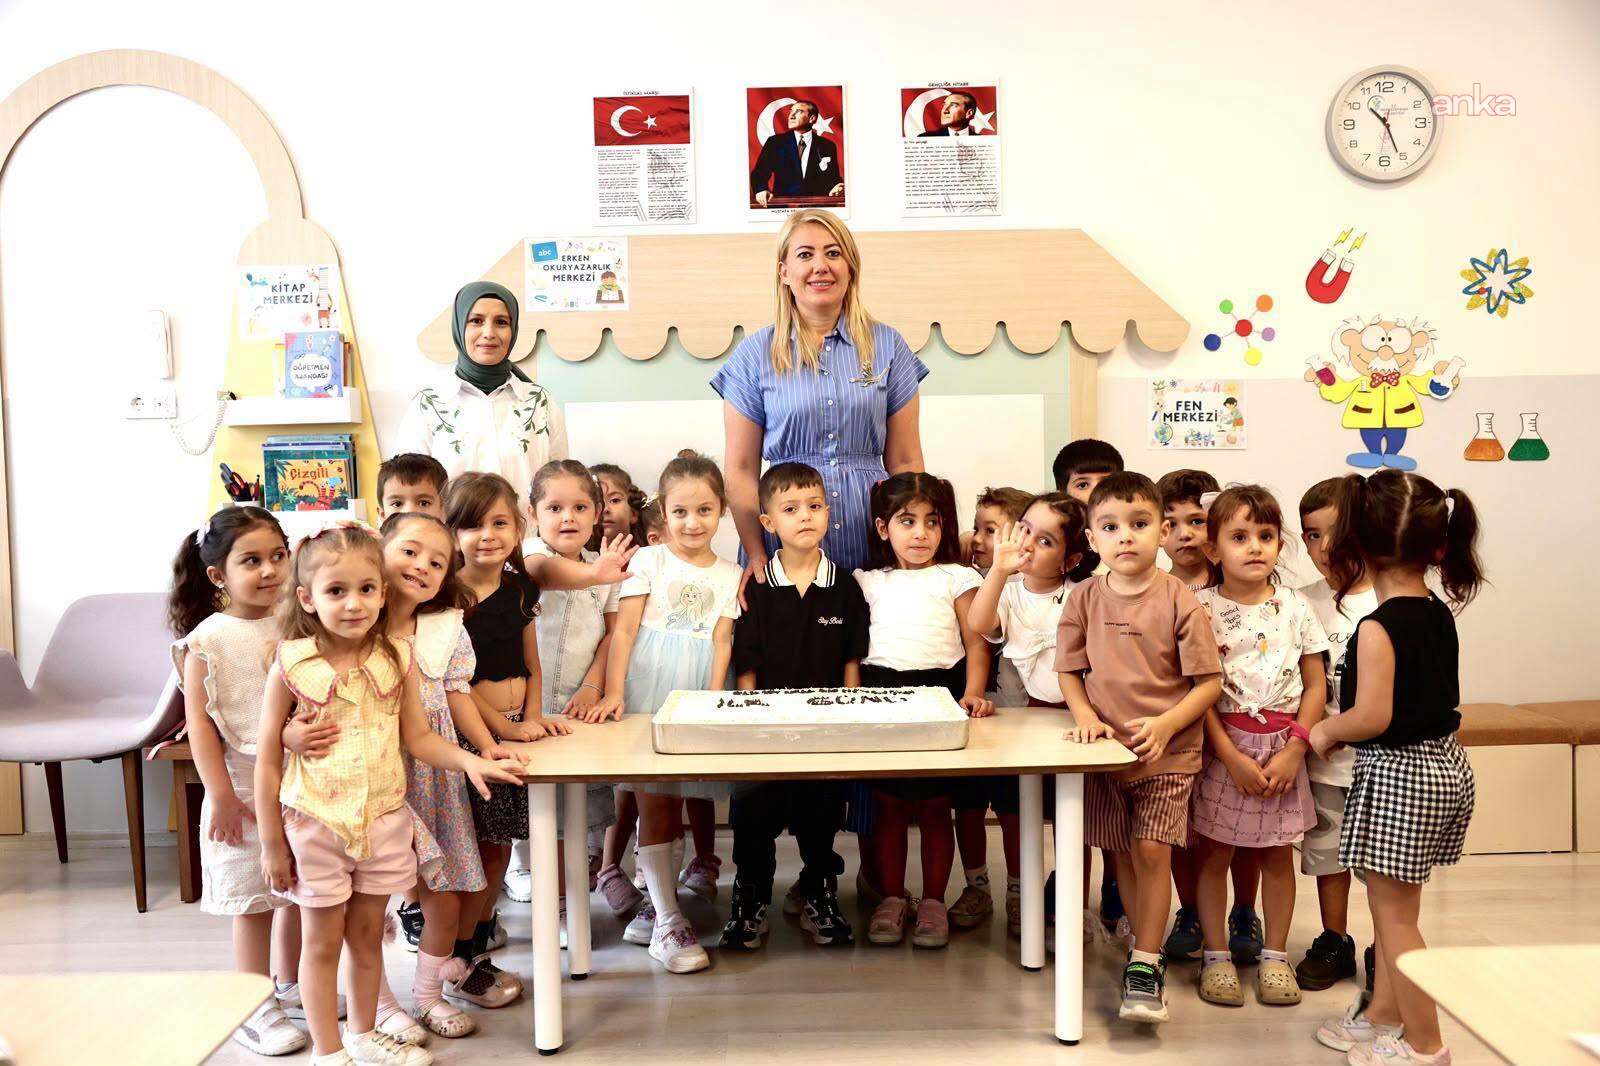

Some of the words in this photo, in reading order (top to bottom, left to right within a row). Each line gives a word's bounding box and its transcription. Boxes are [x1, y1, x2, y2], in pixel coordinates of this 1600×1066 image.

[1361, 87, 1371, 96] 11
[1375, 81, 1394, 93] 12
[1347, 102, 1361, 111] 10
[1413, 100, 1422, 109] 2
[1343, 119, 1355, 130] 9
[1415, 117, 1427, 129] 3
[1349, 140, 1358, 149] 8
[1413, 138, 1421, 146] 4
[1363, 154, 1371, 162] 7
[1379, 155, 1391, 167] 6
[1399, 152, 1408, 161] 5
[538, 249, 552, 257] abc
[553, 272, 595, 282] MERKEZİ
[271, 282, 306, 293] KİTAP
[263, 292, 313, 305] MERKEZİ
[1176, 401, 1202, 411] FEN
[1163, 410, 1218, 422] MERKEZİ
[290, 468, 329, 480] Çizgili
[1220, 605, 1240, 617] Good
